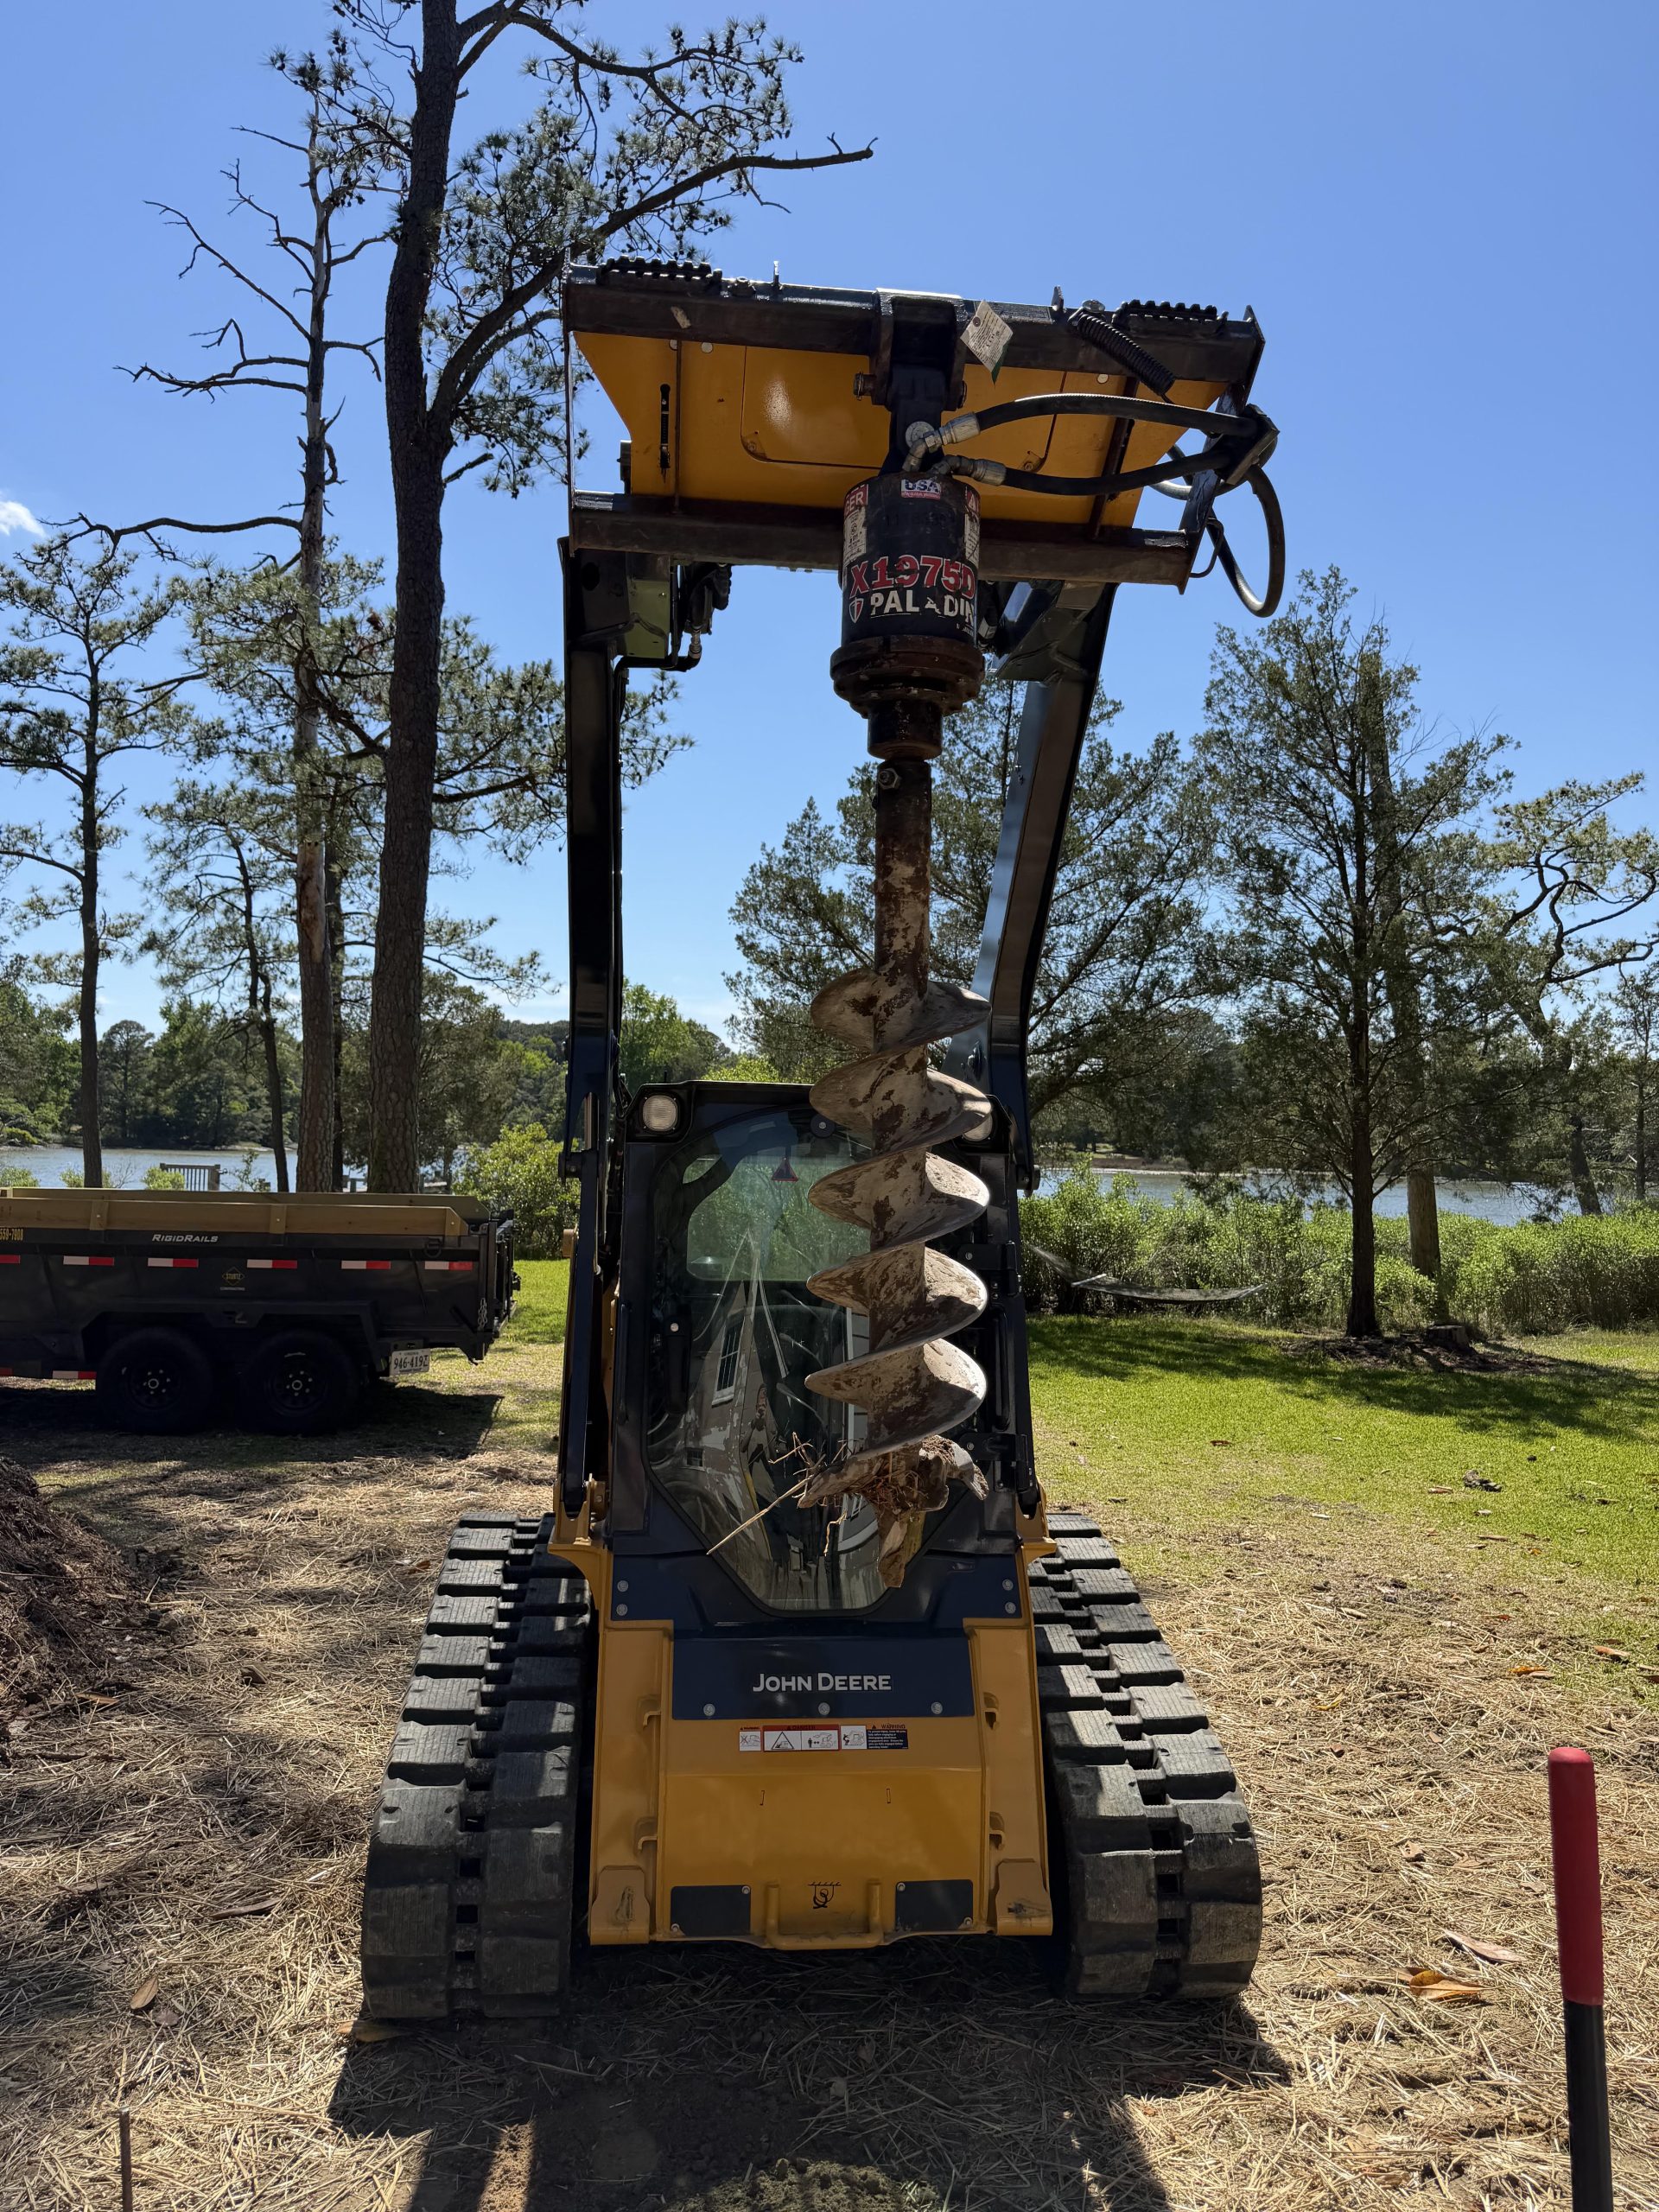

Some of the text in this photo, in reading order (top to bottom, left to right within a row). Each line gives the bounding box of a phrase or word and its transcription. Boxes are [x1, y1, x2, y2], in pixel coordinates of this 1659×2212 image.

[905, 479, 939, 493] USA
[753, 1672, 892, 1692] JOHN DEERE
